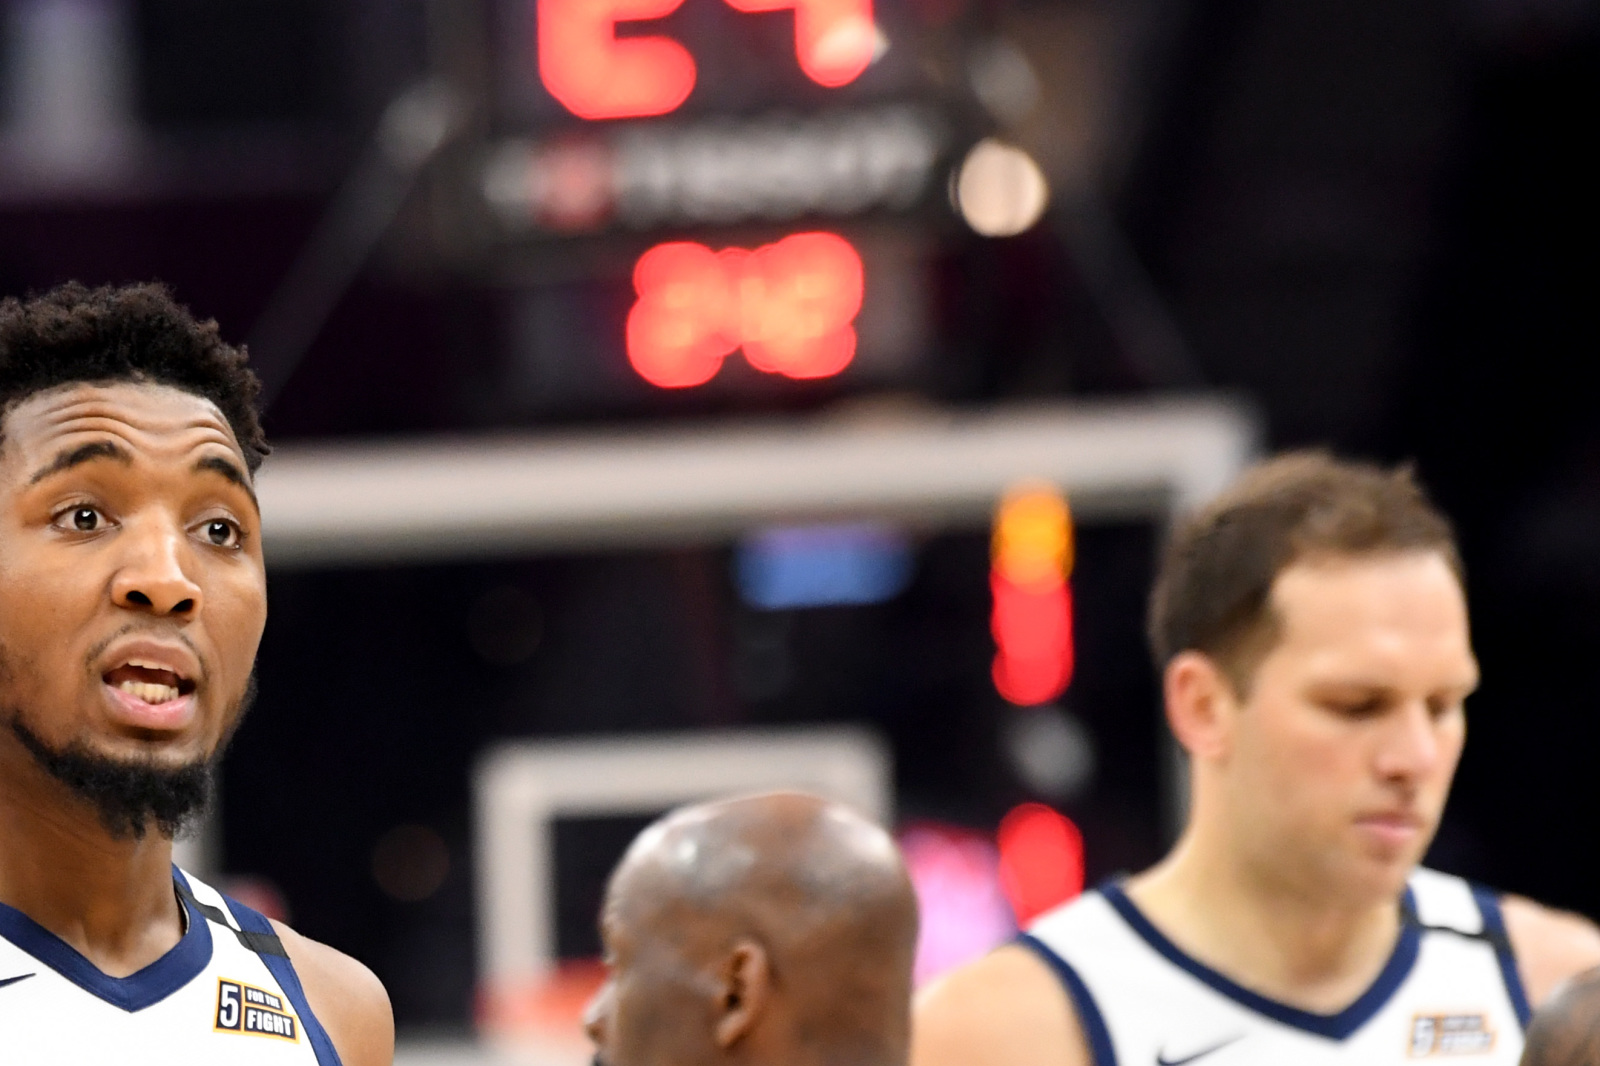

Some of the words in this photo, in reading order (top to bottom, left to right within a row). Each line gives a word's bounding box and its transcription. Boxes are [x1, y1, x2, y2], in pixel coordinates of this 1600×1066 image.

[220, 983, 239, 1028] 5
[246, 988, 265, 1004] FOR
[265, 994, 281, 1009] THE
[246, 1008, 292, 1036] FIGHT
